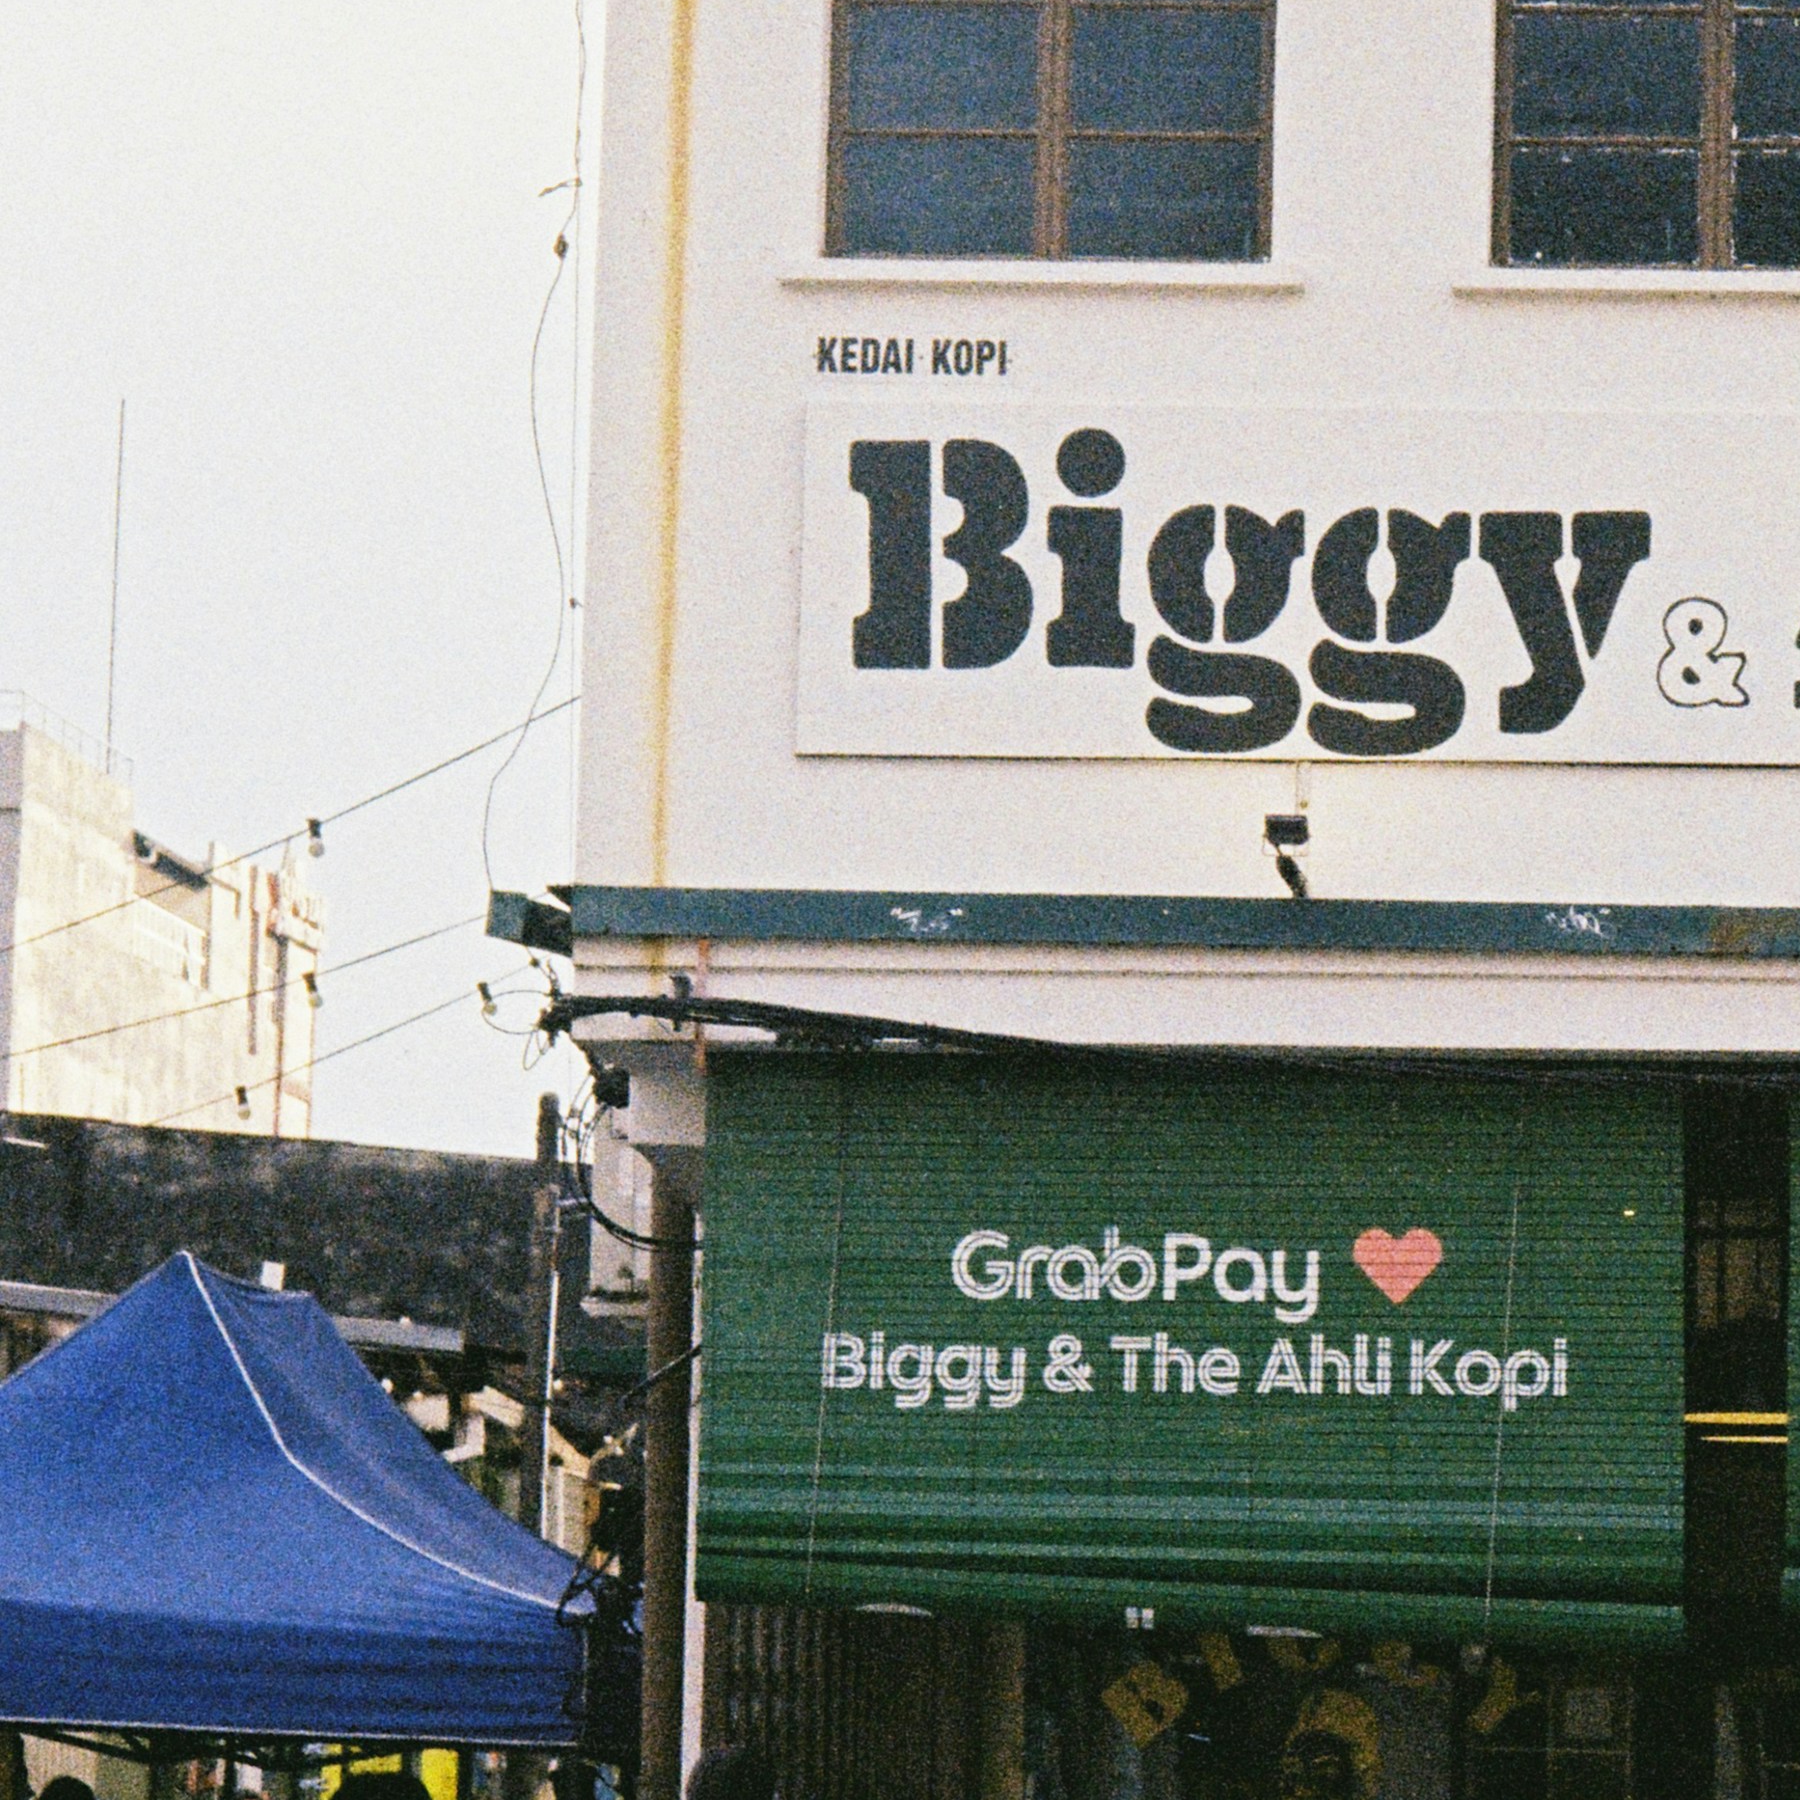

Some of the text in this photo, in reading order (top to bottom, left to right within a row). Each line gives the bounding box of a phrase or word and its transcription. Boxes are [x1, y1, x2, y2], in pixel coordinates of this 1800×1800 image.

[816, 336, 1008, 376] KEDAI KOPI
[848, 427, 1751, 757] Biggy &
[951, 1226, 1321, 1325] GrabPay
[821, 1330, 1569, 1412] Biggy & The Ahli Kopi
